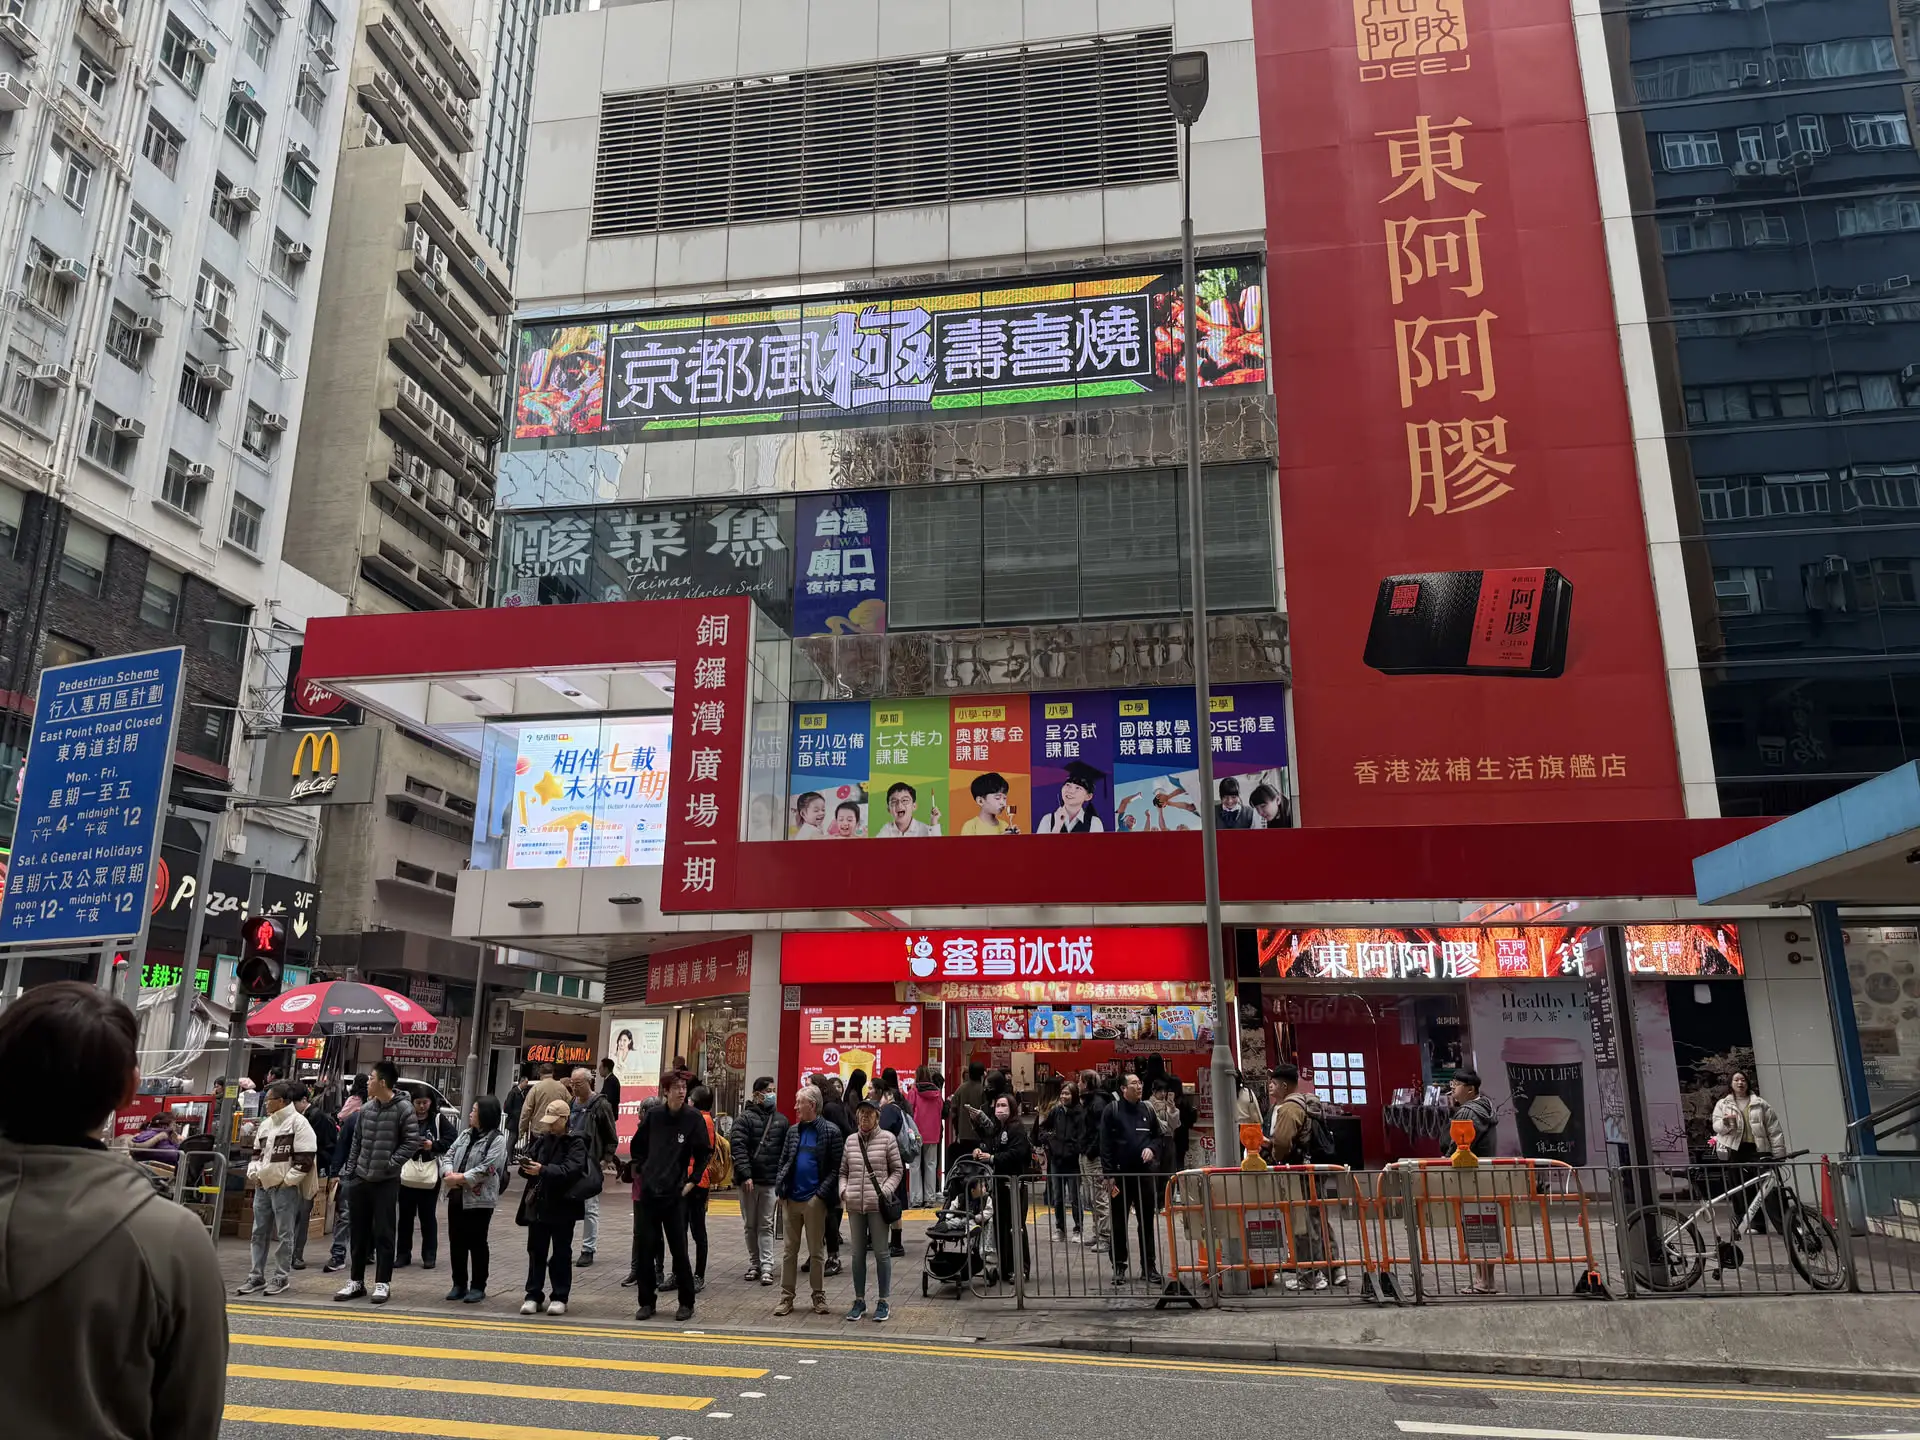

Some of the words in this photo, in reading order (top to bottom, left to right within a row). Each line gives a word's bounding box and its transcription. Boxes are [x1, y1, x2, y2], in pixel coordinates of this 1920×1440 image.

[1359, 54, 1471, 83] DEEJ
[1373, 114, 1516, 518] 東阿阿膠
[814, 506, 869, 537] 台灣
[516, 559, 587, 579] SUAN
[626, 555, 668, 574] CAI
[729, 550, 763, 568] YU
[626, 573, 693, 592] Taiwan
[738, 578, 775, 593] Snack
[806, 578, 876, 595] 夜市美食
[1504, 588, 1536, 635] 阿膠
[58, 674, 114, 692] Pedestrian
[116, 668, 160, 683] Scheme
[49, 683, 165, 720] 行人專用區計劃
[1048, 705, 1069, 716] 小學
[1123, 702, 1145, 713] 中學
[40, 730, 63, 743] East
[65, 725, 93, 740] Point
[95, 719, 122, 735] Road
[125, 714, 163, 729] Closed
[875, 729, 943, 748] 七大能力
[955, 726, 1024, 745] 奧數奪金
[1045, 722, 1098, 741] 呈分試
[1119, 719, 1192, 738] 國際數學
[55, 732, 140, 764] 東角道封閉
[798, 732, 865, 750] 升小必備
[1045, 741, 1081, 758] 課程
[1119, 737, 1192, 756] 競賽課程
[551, 743, 657, 775] 相伴七載
[680, 613, 730, 894] 銅鑼灣廣場一期
[798, 750, 847, 768] 面試班
[875, 748, 909, 765] 課程
[955, 744, 989, 761] 課程
[66, 772, 91, 784] Mon.
[101, 767, 119, 779] Fri.
[1353, 753, 1627, 785] 香港滋補生活旗艦店
[48, 780, 133, 809] 星期一至五
[563, 770, 669, 801] 未來可期
[36, 815, 51, 827] pm
[77, 805, 120, 821] midnight
[123, 806, 142, 827] 12
[30, 828, 53, 844] 下午
[84, 820, 109, 838] 午夜
[17, 855, 39, 868] Sat.
[40, 853, 48, 865] &
[50, 848, 93, 864] General
[95, 844, 144, 859] Holidays
[9, 862, 145, 895] 星期六及公眾假期
[15, 901, 37, 911] noon
[69, 892, 112, 906] midnight
[114, 892, 134, 913] 12
[171, 875, 239, 916] Pzza
[294, 890, 315, 909] 3/F
[12, 913, 36, 930] 中午
[75, 907, 101, 924] 午夜
[942, 935, 1095, 976] 蜜雪冰城
[1313, 940, 1482, 979] 東阿阿膠
[649, 949, 750, 991] 銅鑼灣廣場一期
[1501, 992, 1565, 1009] Healthy
[809, 1015, 912, 1045] 雪王推荐
[433, 1035, 454, 1050] 9625
[527, 1044, 556, 1063] GRILL
[825, 1053, 838, 1063] 20
[1549, 1066, 1579, 1081] LIFE
